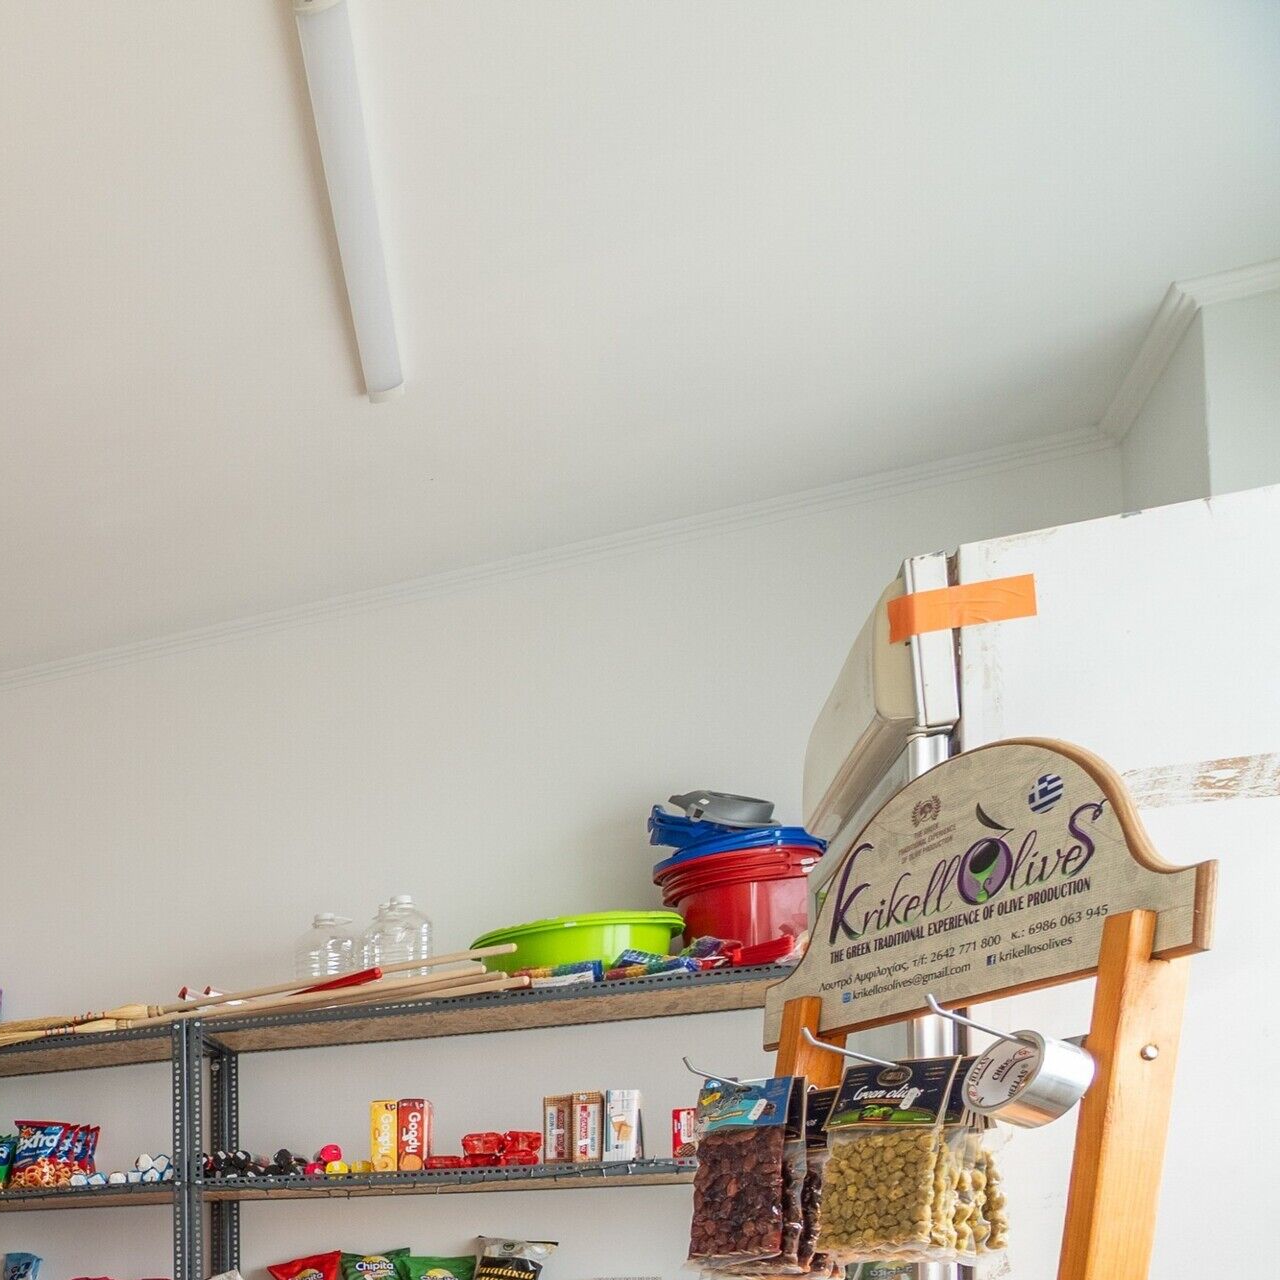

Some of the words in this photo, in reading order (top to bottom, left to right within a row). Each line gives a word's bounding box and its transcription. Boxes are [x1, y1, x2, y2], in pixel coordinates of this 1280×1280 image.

[829, 950, 845, 965] THE
[845, 940, 872, 960] GREEK
[873, 926, 925, 952] TRADITIONAL
[927, 910, 980, 937] EXPERIENCE
[981, 905, 994, 921] OF
[996, 897, 1025, 918] OLIVE
[1026, 877, 1091, 909] PRODUCTION
[818, 972, 853, 993] Λουτρό
[853, 961, 910, 987] Αμφιλοχίας,
[929, 947, 958, 964] 2642
[958, 941, 978, 958] 771
[980, 934, 1002, 950] 800
[1027, 918, 1057, 936] 6986
[1060, 911, 1083, 928] 063
[1085, 903, 1110, 921] 945
[998, 935, 1074, 963] krikellosolives
[851, 961, 971, 1000] krikellosolives@gmail.com
[852, 1083, 895, 1102] Green
[897, 1083, 923, 1101] olis
[19, 1128, 60, 1152] extra
[404, 1111, 422, 1153] Goody
[355, 1261, 394, 1273] Chipita
